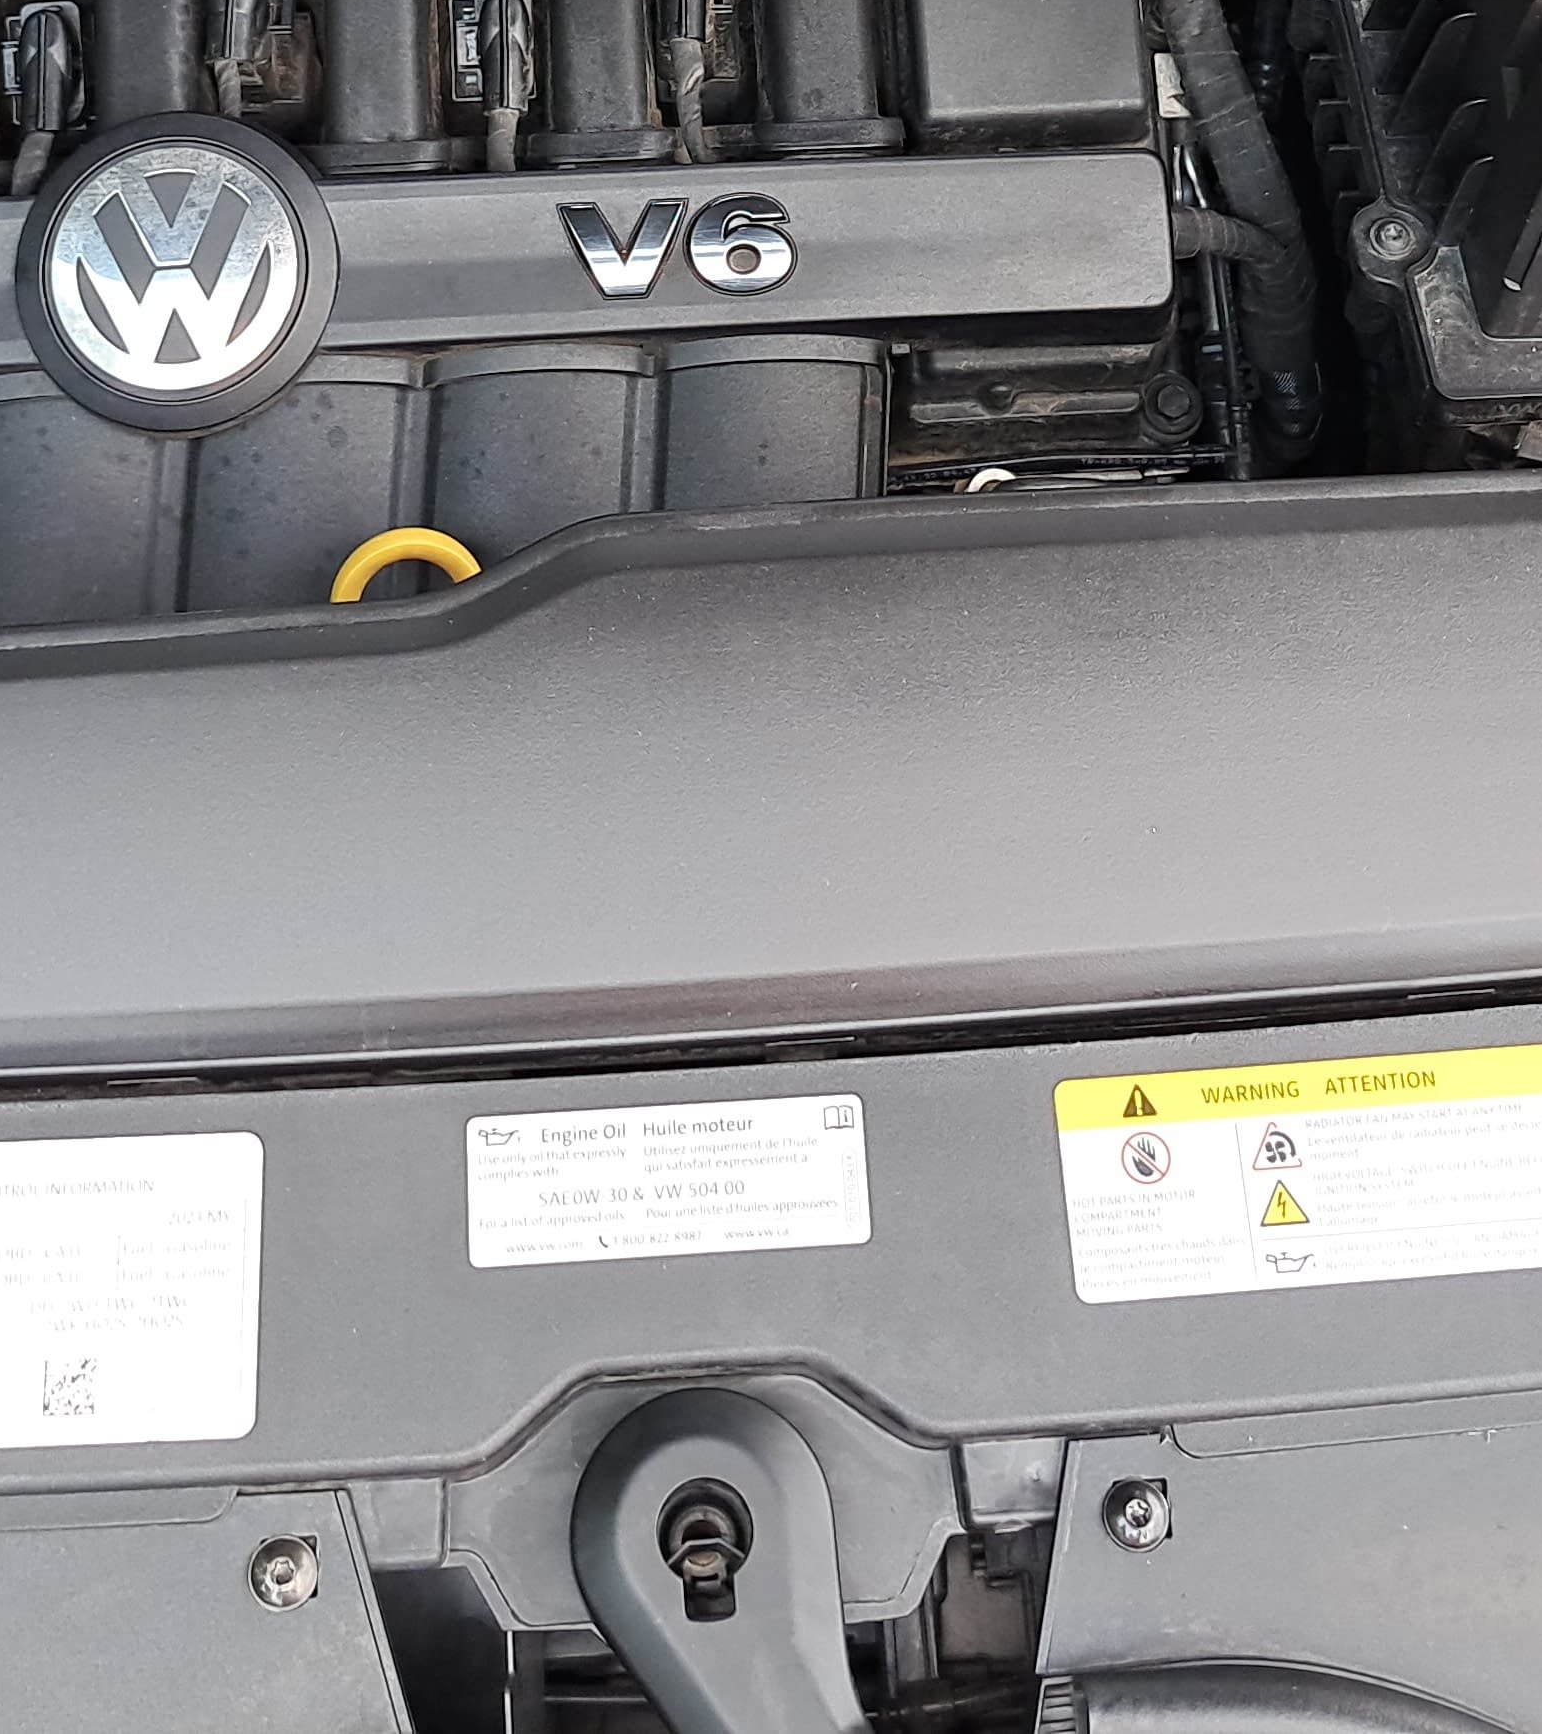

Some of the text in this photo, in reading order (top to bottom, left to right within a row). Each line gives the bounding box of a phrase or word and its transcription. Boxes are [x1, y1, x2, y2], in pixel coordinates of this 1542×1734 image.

[557, 191, 797, 298] V6
[51, 139, 307, 400] VW
[1200, 1069, 1437, 1105] WARNING ATTENTION
[541, 1122, 626, 1146] Engine Oil
[643, 1117, 753, 1137] Huile moteur
[546, 1150, 569, 1161] that
[573, 1146, 626, 1160] expressly
[644, 1145, 686, 1156] Utilisez
[533, 1167, 559, 1177] with
[633, 1186, 644, 1201] &
[654, 1183, 683, 1200] VW
[689, 1182, 718, 1197] 504
[725, 1180, 745, 1195] 00
